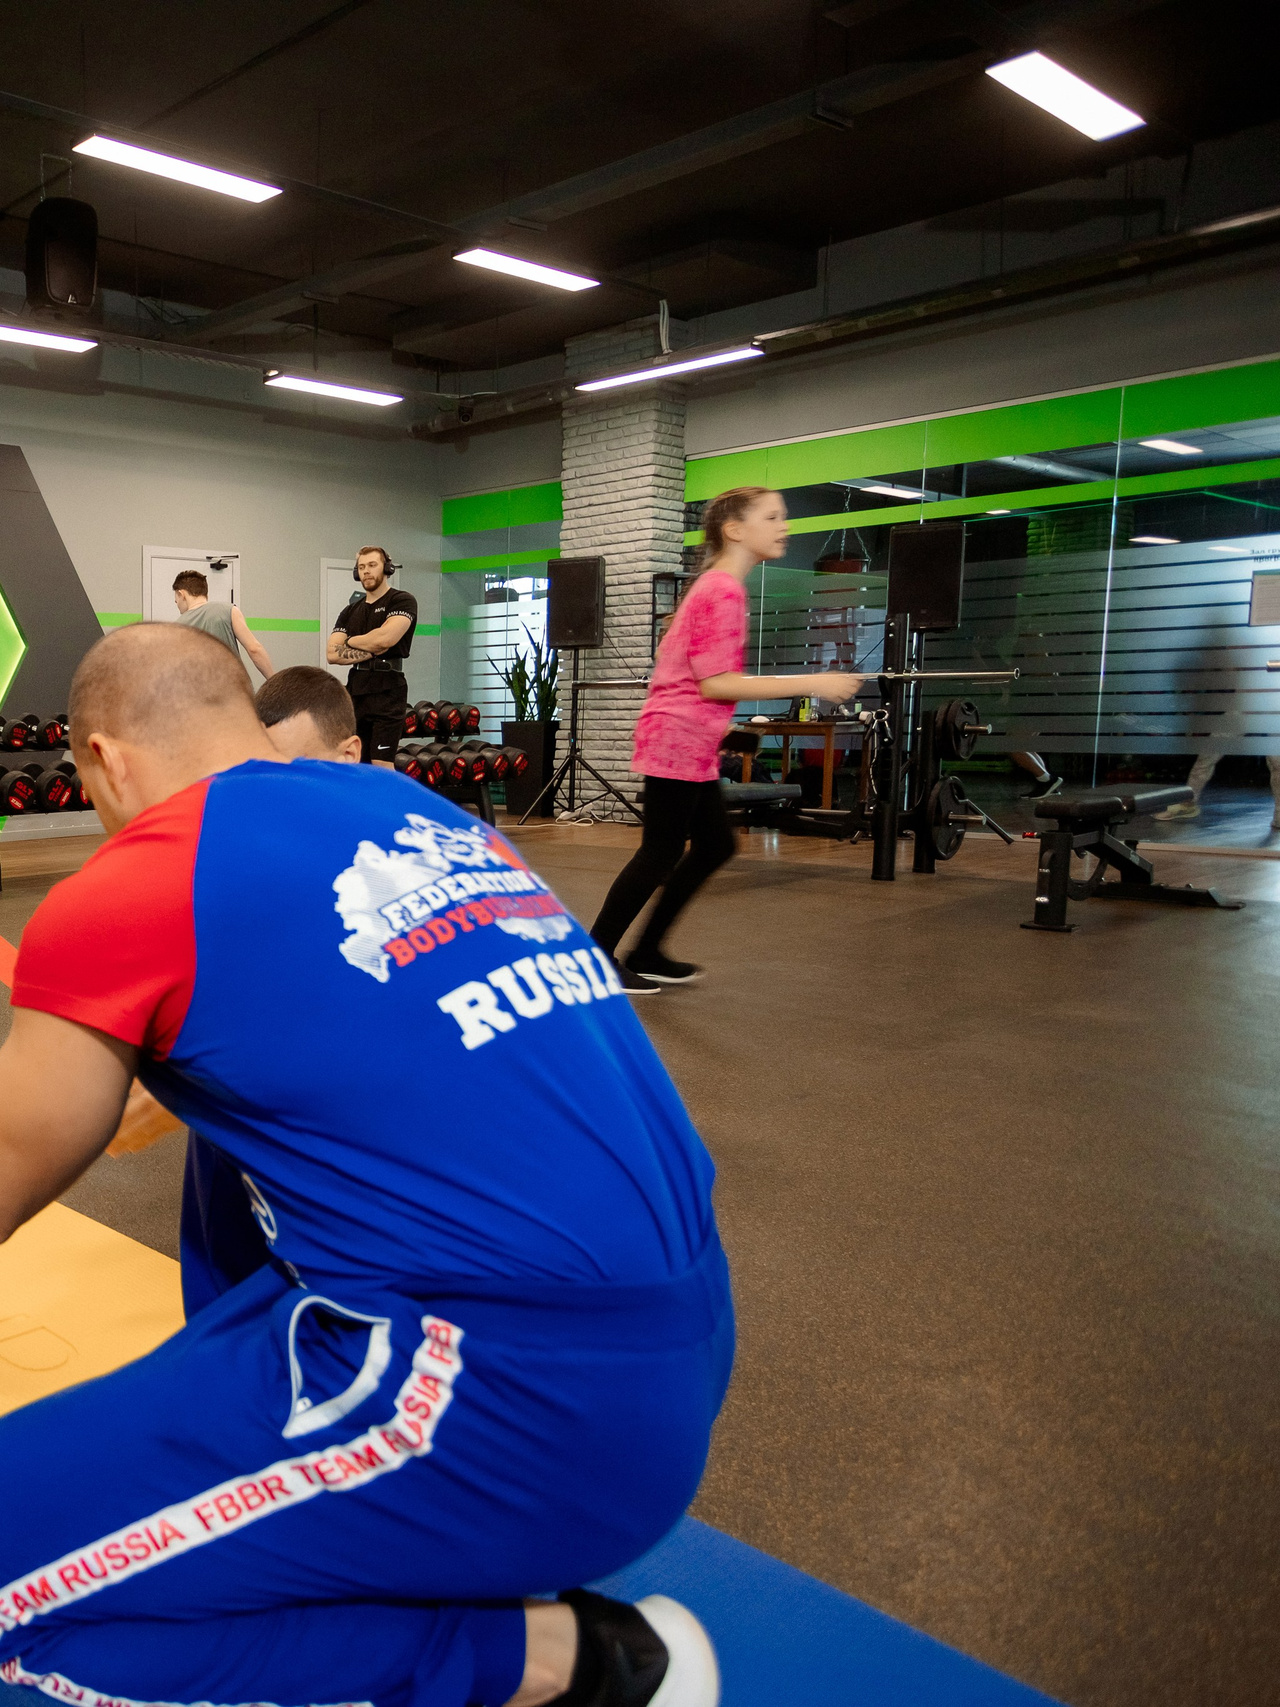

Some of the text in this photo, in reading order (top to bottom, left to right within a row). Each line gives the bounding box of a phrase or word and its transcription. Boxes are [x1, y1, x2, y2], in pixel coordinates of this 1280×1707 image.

[380, 869, 537, 930] FEDERATION
[58, 1519, 187, 1593] RUSSIA
[192, 1474, 294, 1532] FBBR
[290, 1443, 387, 1486] TEAM
